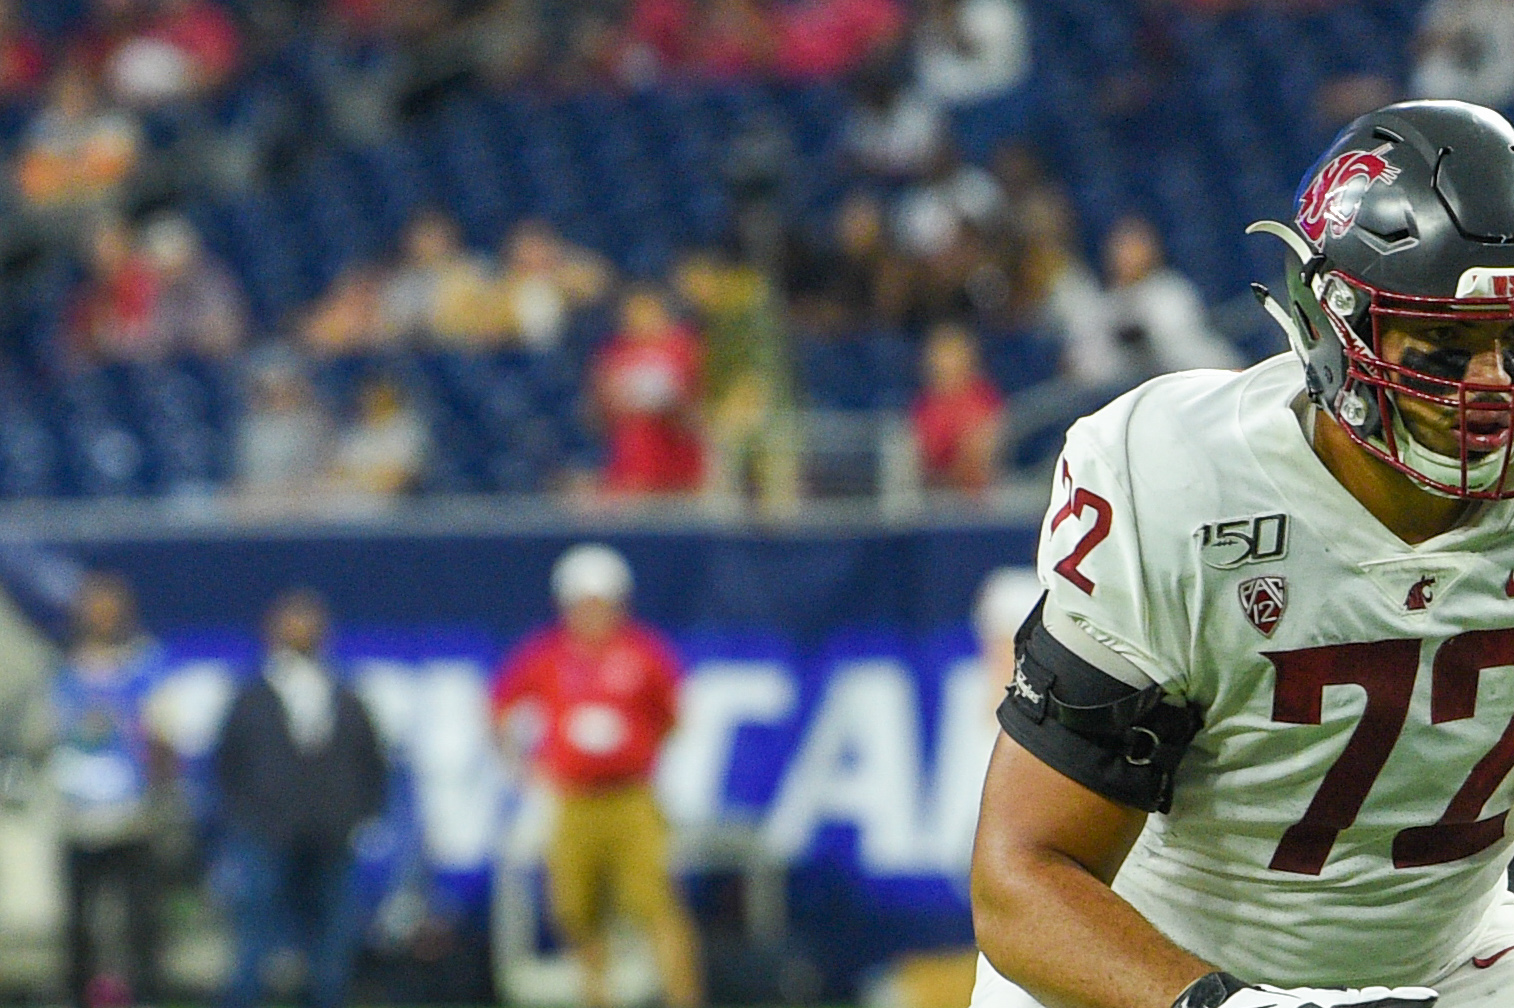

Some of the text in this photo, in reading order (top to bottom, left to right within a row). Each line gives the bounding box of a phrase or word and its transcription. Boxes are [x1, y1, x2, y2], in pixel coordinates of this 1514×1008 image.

[1192, 513, 1287, 566] 150
[1240, 577, 1285, 614] PAC
[1253, 600, 1278, 625] 12
